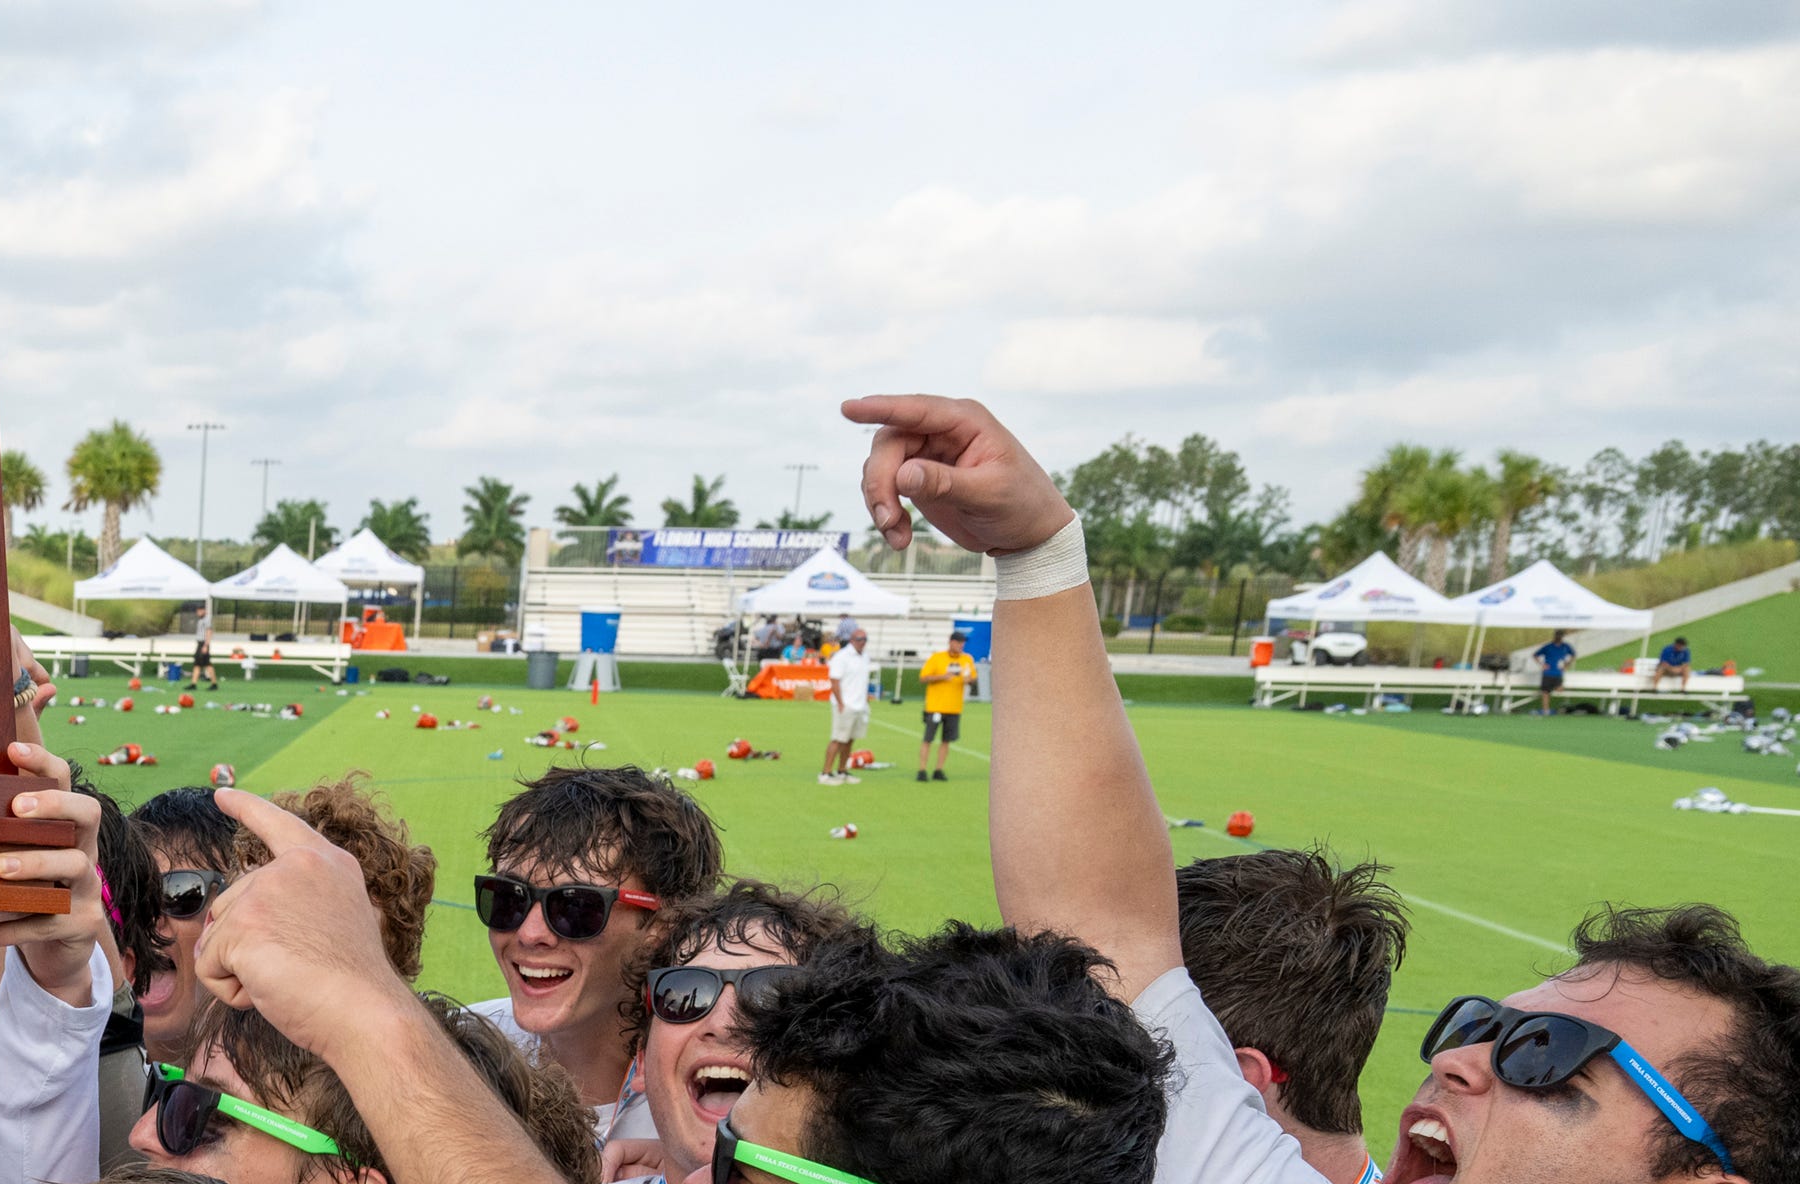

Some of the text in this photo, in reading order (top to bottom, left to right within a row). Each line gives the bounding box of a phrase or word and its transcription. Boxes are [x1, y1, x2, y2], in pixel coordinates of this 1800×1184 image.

[653, 530, 701, 547] FLORIDA
[703, 531, 732, 547] HIGH
[733, 531, 778, 548] SCHOOL
[1643, 1072, 1659, 1089] STATE
[1656, 1086, 1693, 1124] CHAMPIONSHIPS
[777, 1160, 798, 1174] STATE
